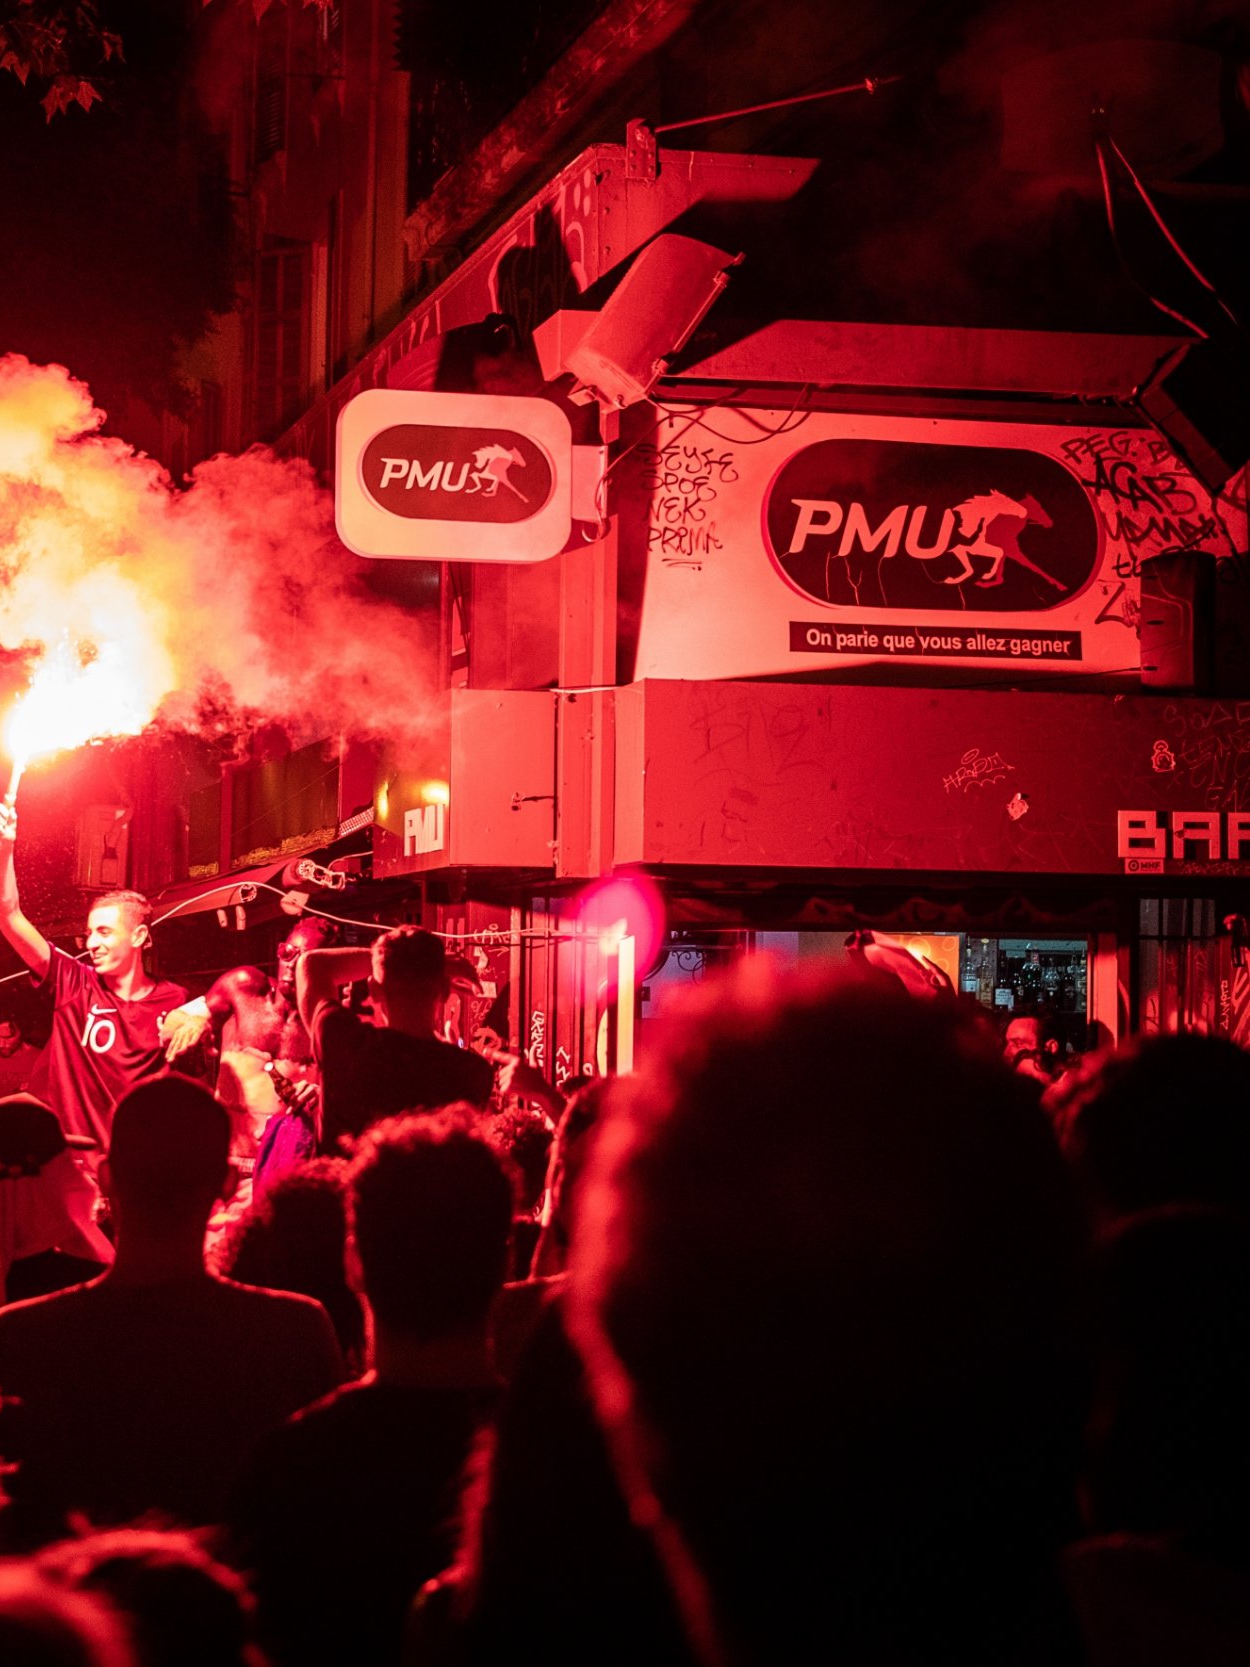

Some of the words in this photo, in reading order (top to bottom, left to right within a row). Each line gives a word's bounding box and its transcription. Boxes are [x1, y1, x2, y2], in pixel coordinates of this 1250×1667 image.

[380, 457, 471, 492] PMU
[1082, 454, 1197, 514] ACAB
[788, 498, 955, 560] PMU
[805, 628, 832, 645] On
[835, 630, 879, 650] parie
[883, 634, 915, 652] que
[920, 634, 962, 650] vous
[966, 634, 1006, 651] allez
[1010, 638, 1071, 656] gagner
[80, 1012, 116, 1054] 10
